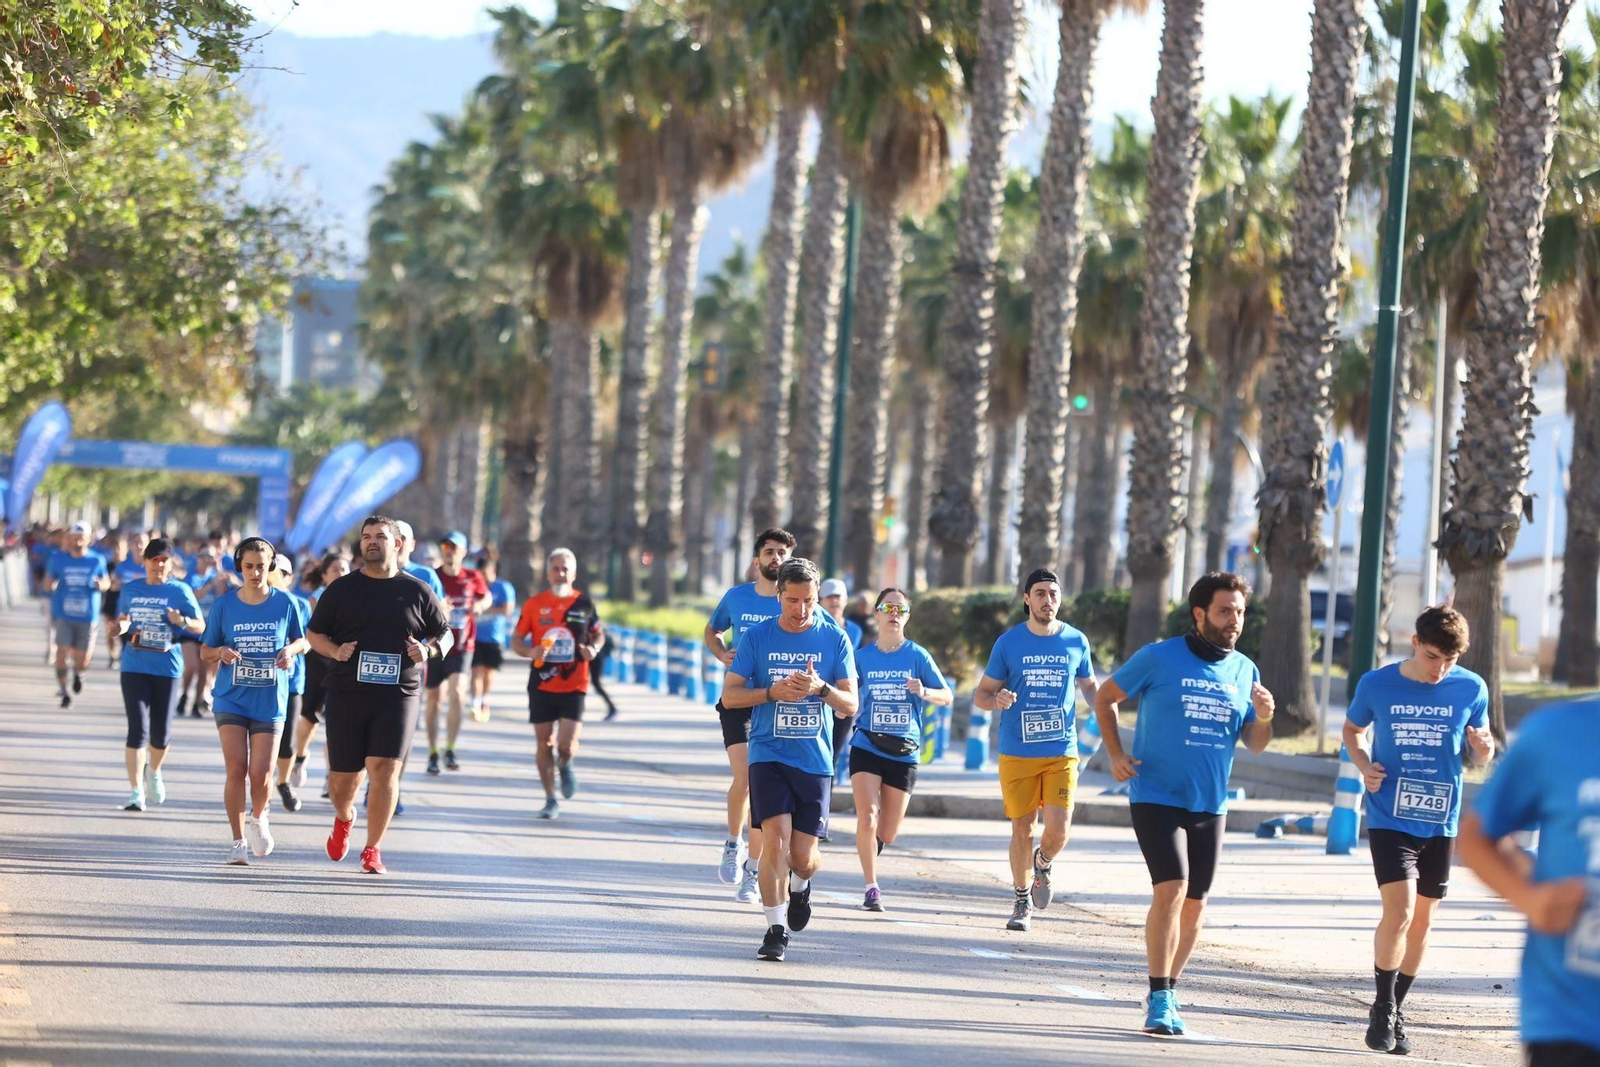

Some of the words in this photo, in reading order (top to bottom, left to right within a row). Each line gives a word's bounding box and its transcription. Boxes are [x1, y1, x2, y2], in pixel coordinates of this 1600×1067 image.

[131, 597, 168, 606] mayoral
[233, 621, 279, 632] mayoral
[768, 652, 822, 663] mayoral
[1022, 655, 1070, 665] mayoral
[239, 667, 270, 678] 1821
[364, 664, 396, 674] 1879
[867, 669, 912, 680] mayoral
[1186, 702, 1232, 716] MAKES
[1390, 704, 1453, 717] mayoral
[781, 715, 817, 726] 1893
[876, 714, 908, 724] 1616
[1184, 710, 1231, 723] FRIENDS
[1028, 720, 1060, 732] 2158
[1391, 723, 1450, 733] RUNNING
[1396, 731, 1442, 739] MAKES
[1395, 738, 1442, 747] FRIENDS
[1404, 794, 1444, 810] 1748
